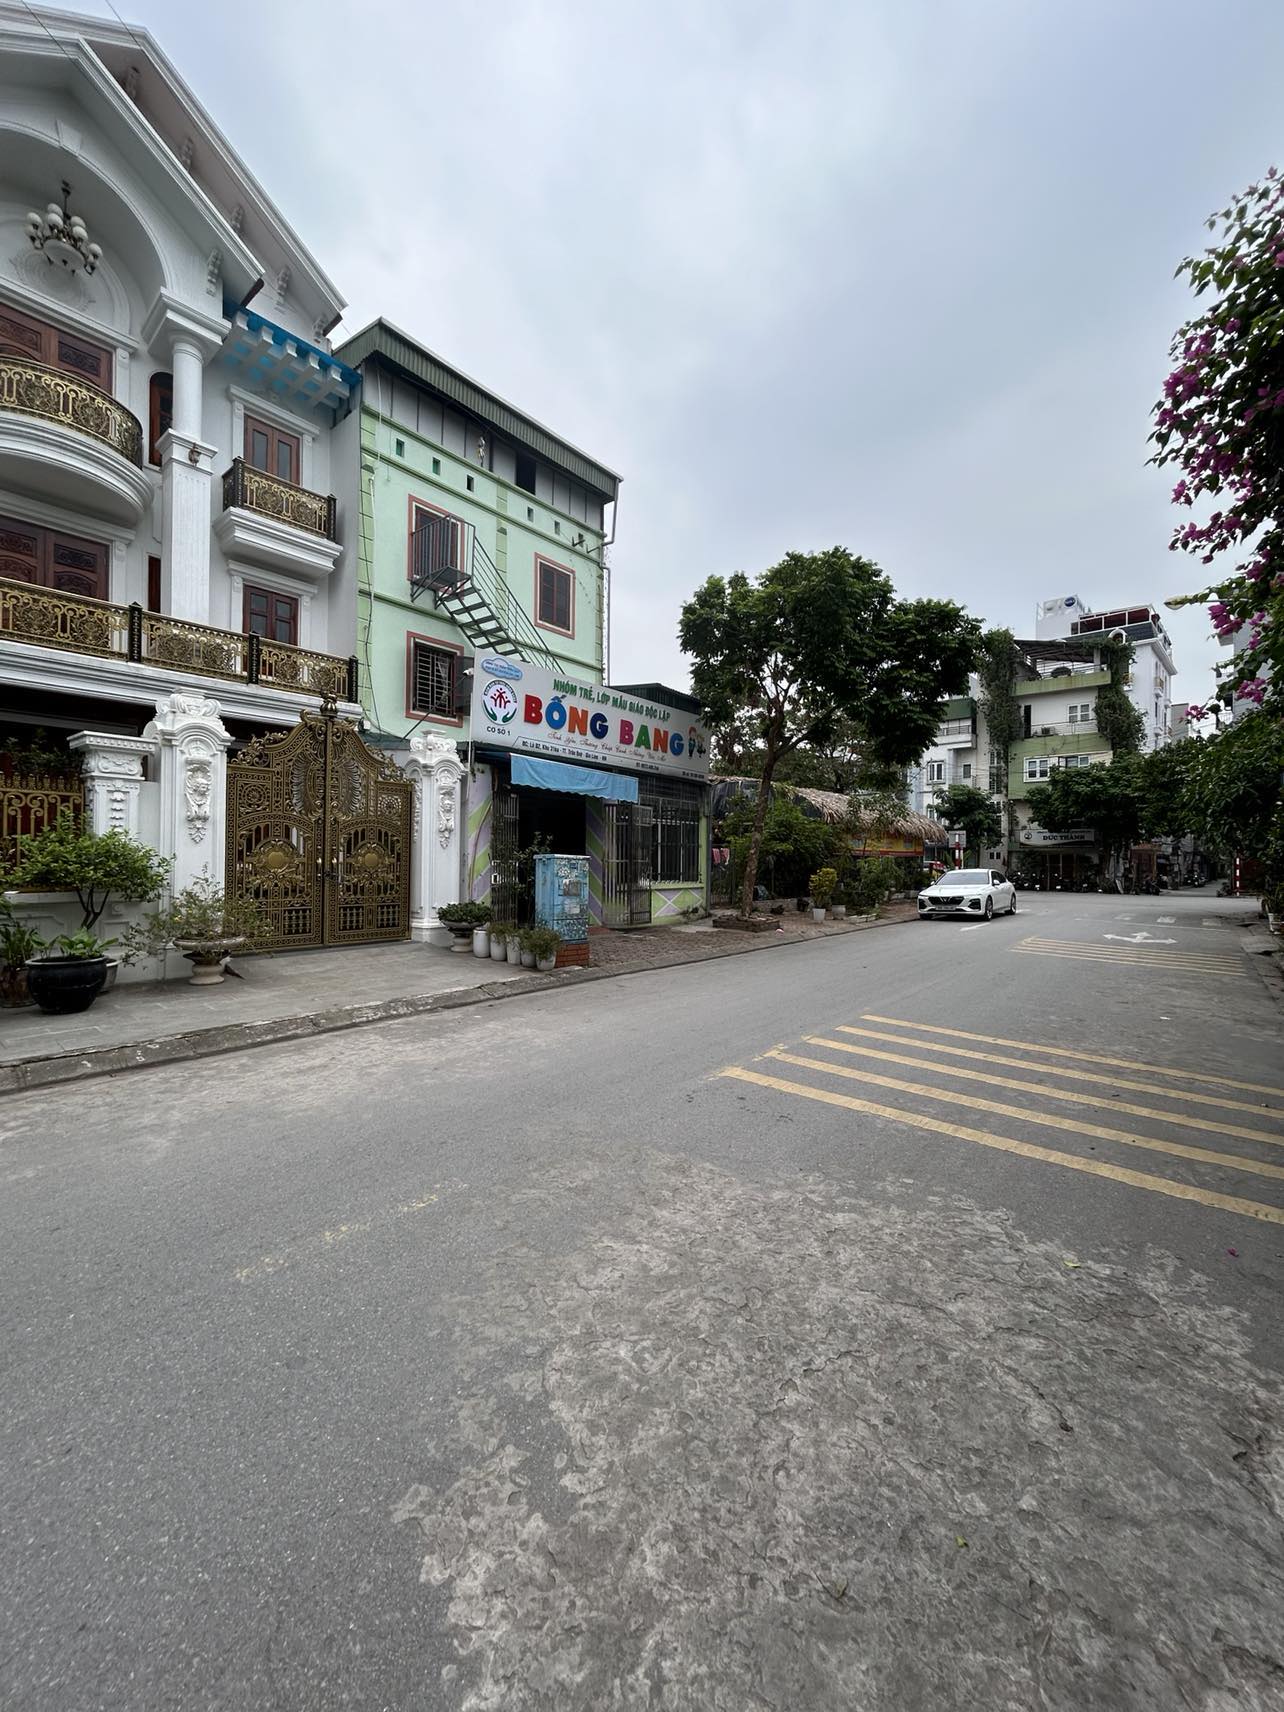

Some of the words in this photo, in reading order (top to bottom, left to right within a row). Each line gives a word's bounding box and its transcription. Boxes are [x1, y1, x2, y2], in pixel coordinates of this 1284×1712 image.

[553, 678, 577, 696] NHÓM
[628, 701, 644, 715] GIÁO
[524, 694, 609, 739] BỐNG
[619, 719, 685, 756] BANG
